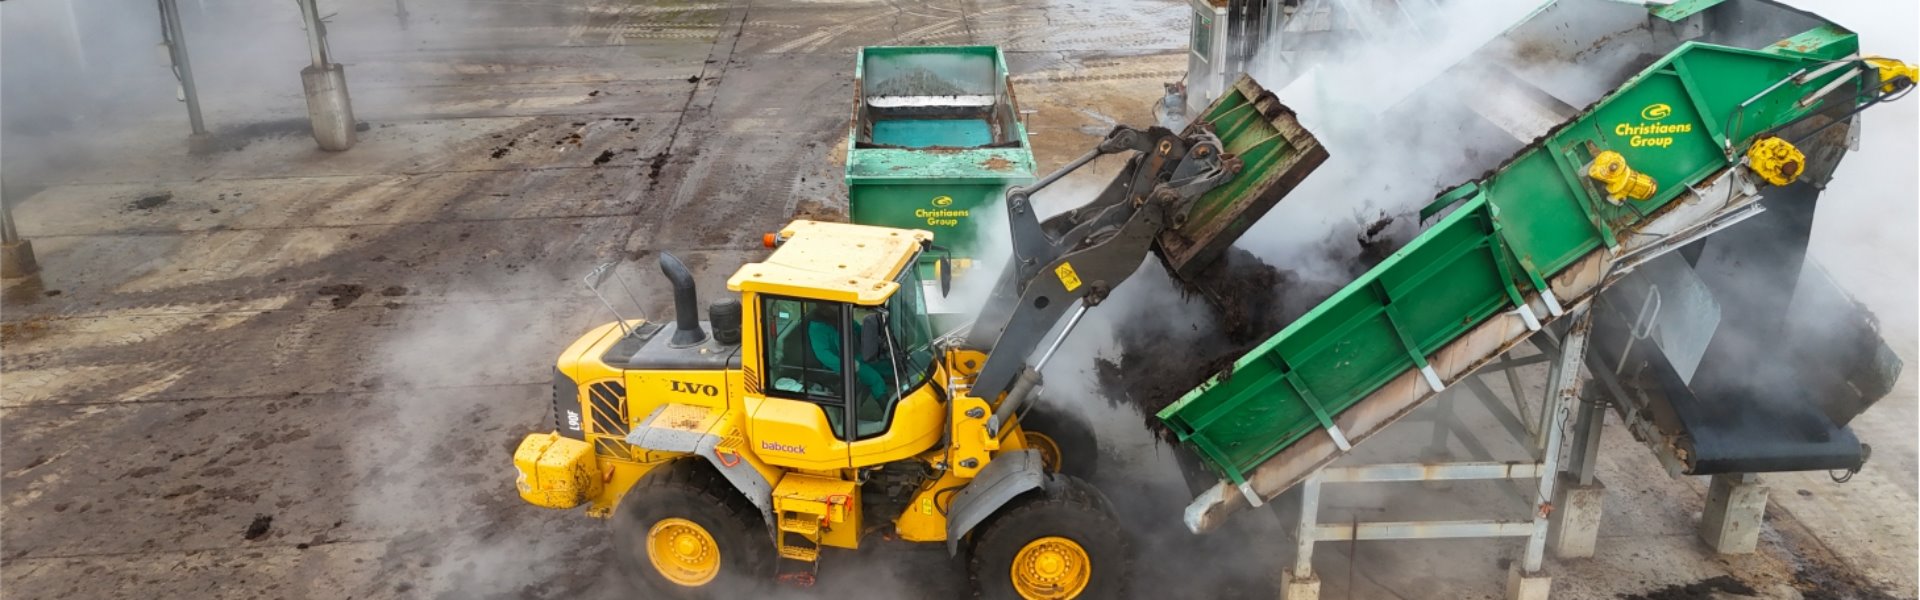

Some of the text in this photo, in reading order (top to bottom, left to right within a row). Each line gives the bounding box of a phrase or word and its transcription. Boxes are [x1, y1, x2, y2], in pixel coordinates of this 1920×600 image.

[1615, 122, 1692, 136] Christiaens
[1630, 135, 1673, 148] Group
[915, 208, 969, 218] Christiaens
[927, 217, 958, 227] Group
[670, 379, 719, 397] LVO
[567, 409, 581, 431] L90F
[761, 440, 806, 454] babcock
